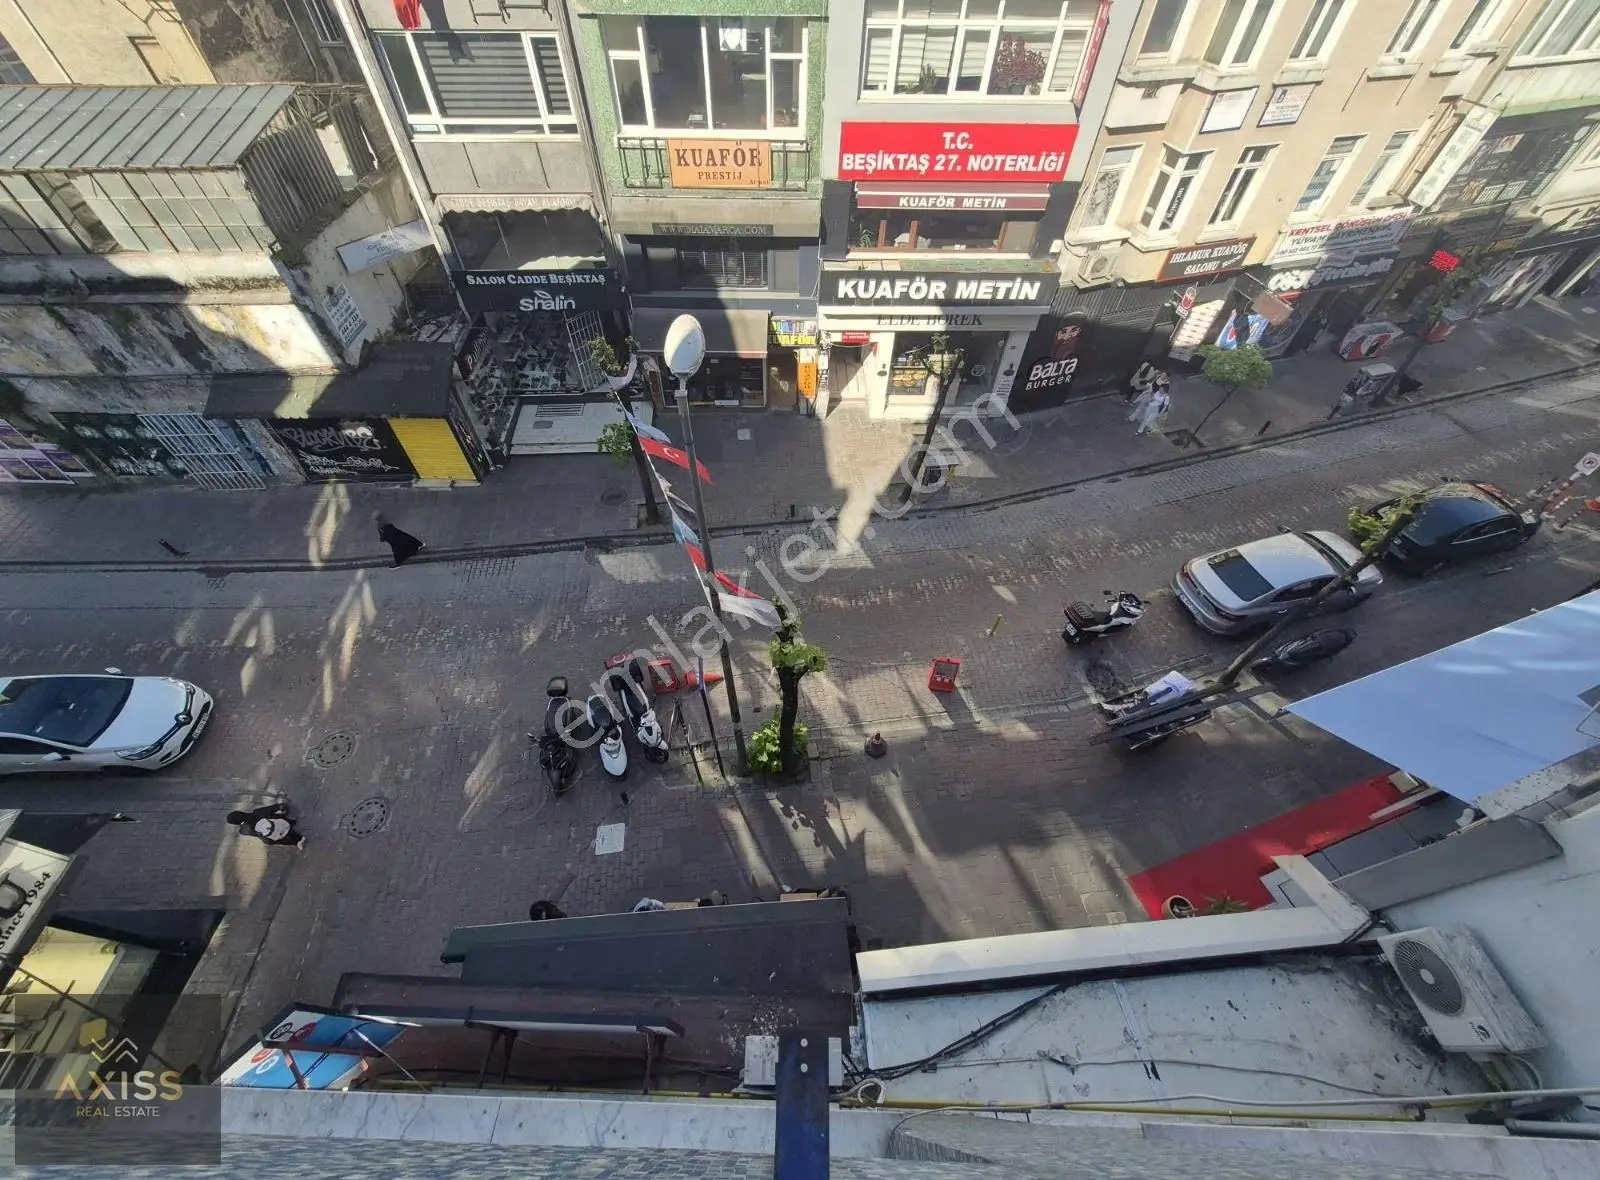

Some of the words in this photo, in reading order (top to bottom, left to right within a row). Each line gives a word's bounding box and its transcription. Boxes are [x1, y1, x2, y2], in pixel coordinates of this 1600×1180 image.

[942, 132, 974, 149] T.C.
[676, 141, 763, 167] KUAFÖR
[842, 150, 930, 174] BEŞİKTAŞ
[934, 155, 961, 171] 27.
[967, 152, 1066, 172] NOTERLİĞİ
[899, 194, 955, 209] KUAFÖR
[962, 195, 1007, 209] METİN
[1289, 223, 1333, 237] KENTSEL
[1211, 242, 1249, 257] KUAFÖR
[1183, 261, 1220, 275] SALONU
[466, 274, 506, 285] SALON
[507, 274, 548, 285] CADDE
[550, 273, 606, 286] BEŞİKTAŞ
[837, 275, 948, 300] KUAFÖR
[954, 277, 1041, 301] METİN
[25, 871, 51, 907] 1984
